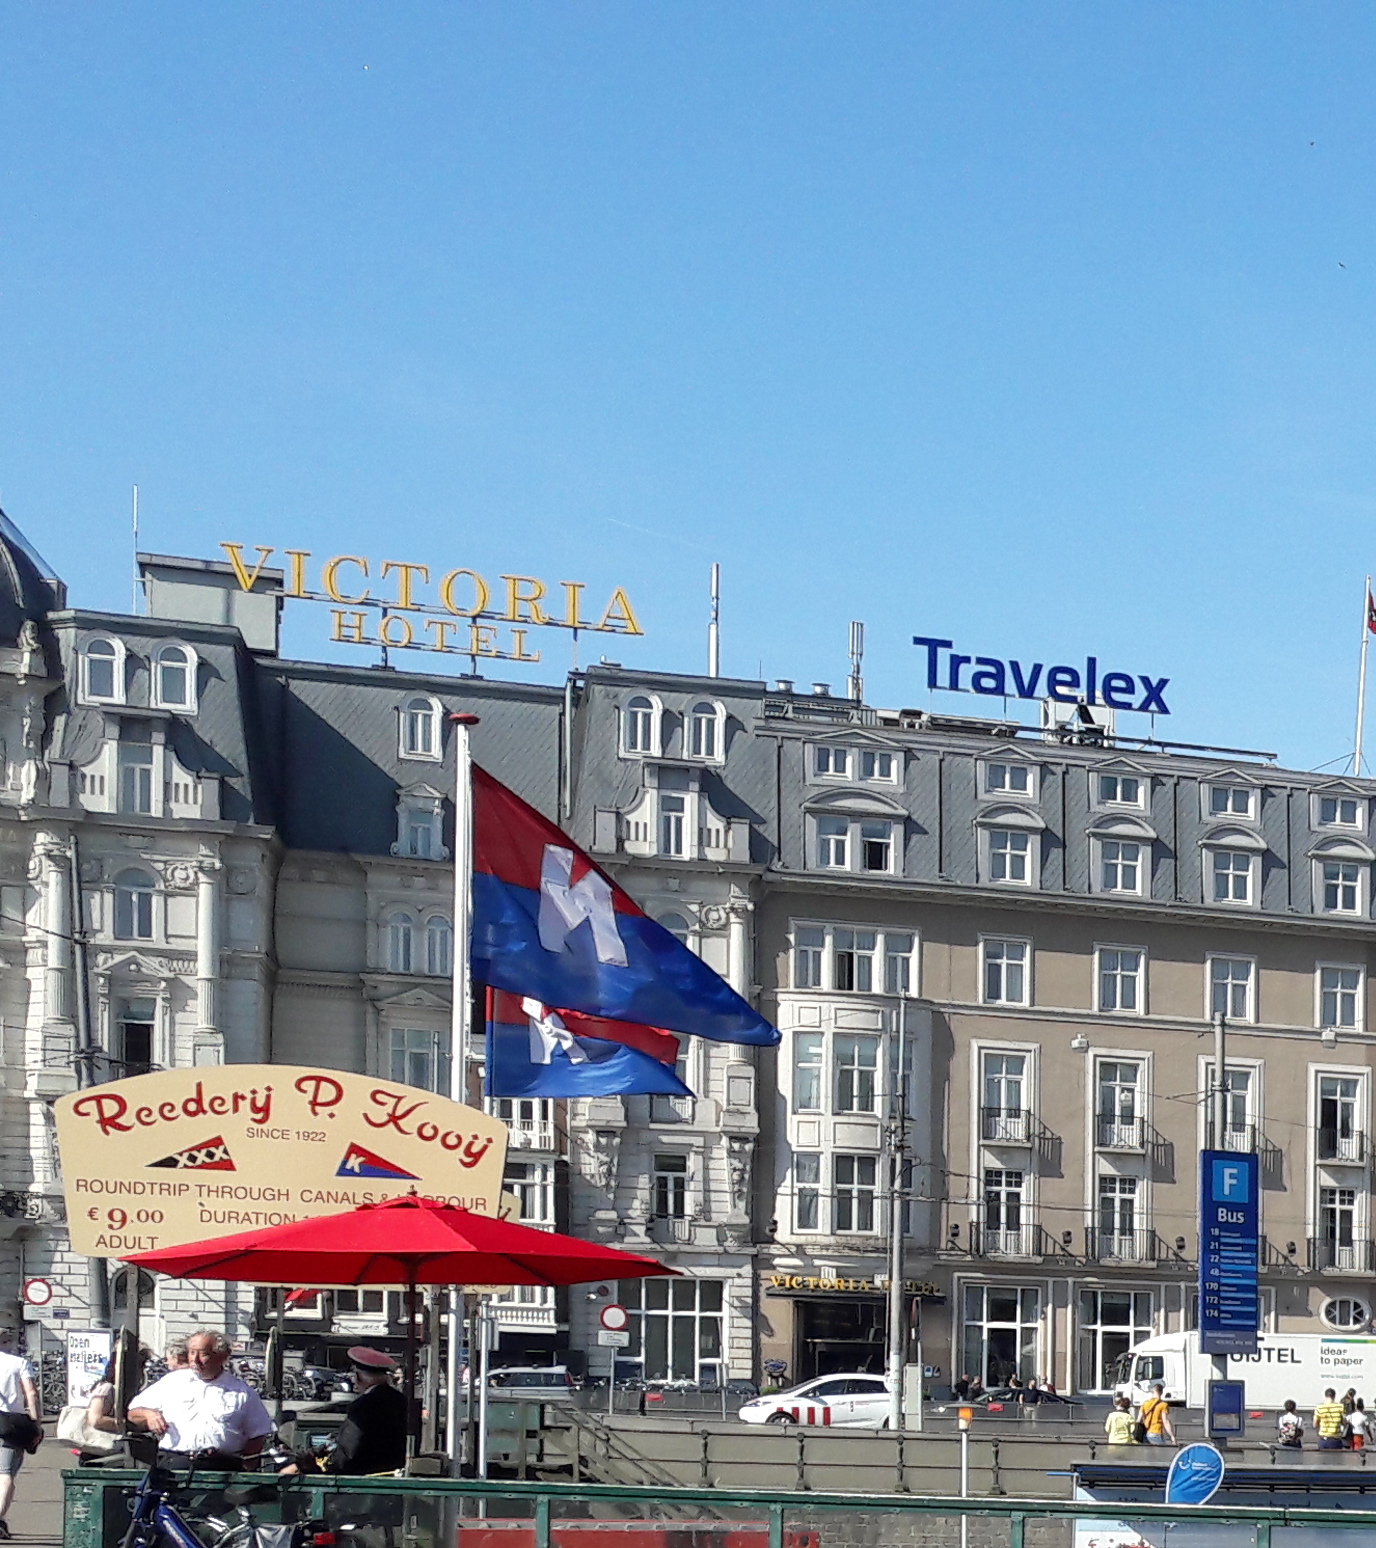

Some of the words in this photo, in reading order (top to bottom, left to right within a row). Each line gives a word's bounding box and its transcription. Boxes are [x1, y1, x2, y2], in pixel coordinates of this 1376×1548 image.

[219, 541, 644, 635] VICTORIA
[329, 609, 540, 662] HOTEL
[912, 635, 1171, 715] Travelex
[73, 1081, 274, 1136] Reederij
[294, 1074, 344, 1119] P.
[363, 1089, 494, 1168] Kooij
[246, 1126, 290, 1141] SINCE
[296, 1129, 327, 1143] 1922
[76, 1178, 190, 1197] ROUNDTRIP
[195, 1183, 290, 1202] THROUGH
[300, 1189, 374, 1204] CANALS
[1223, 1167, 1238, 1196] F
[87, 1206, 99, 1221] €
[107, 1207, 164, 1231] 9.00
[200, 1209, 296, 1226] DURATION
[1217, 1207, 1245, 1224] Bus
[95, 1234, 159, 1250] ADULT
[769, 1275, 870, 1292] VICTORIA
[1320, 1346, 1348, 1355] ideas
[1320, 1356, 1331, 1364] to
[1333, 1358, 1364, 1367] paper
